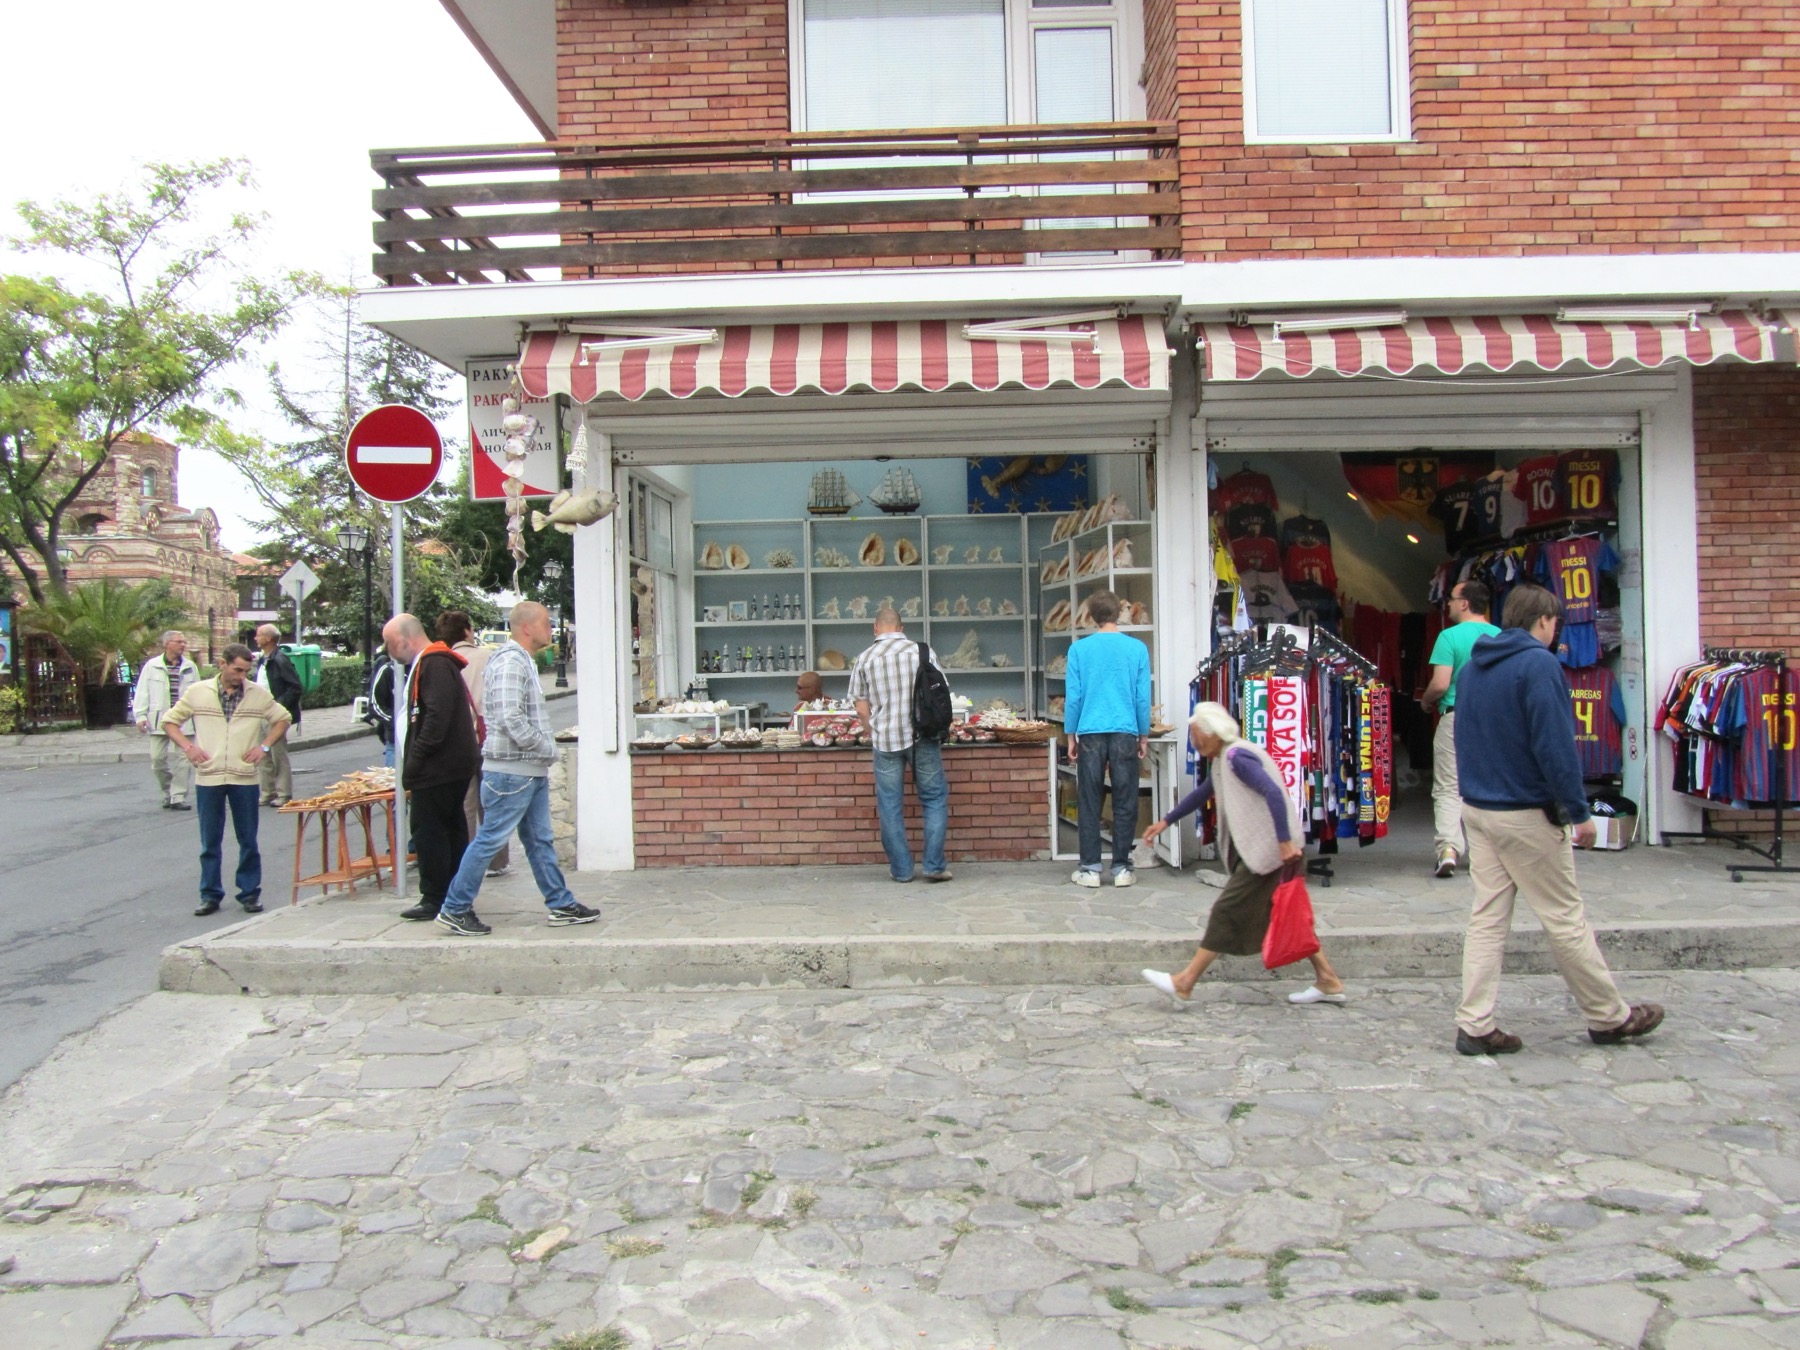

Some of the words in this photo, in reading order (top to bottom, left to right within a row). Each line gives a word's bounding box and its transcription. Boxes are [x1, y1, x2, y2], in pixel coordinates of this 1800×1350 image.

[1526, 468, 1556, 481] ROONE
[1568, 461, 1600, 471] MESSI
[1479, 484, 1501, 495] TORRE
[1532, 480, 1555, 510] 10
[1568, 474, 1600, 509] 10
[1453, 501, 1470, 531] 7
[1485, 496, 1497, 524] 9
[1561, 557, 1587, 568] MESSI
[1561, 569, 1592, 600] 10
[1762, 694, 1796, 706] MESI
[1575, 701, 1593, 734] 4
[1763, 709, 1796, 751] 10
